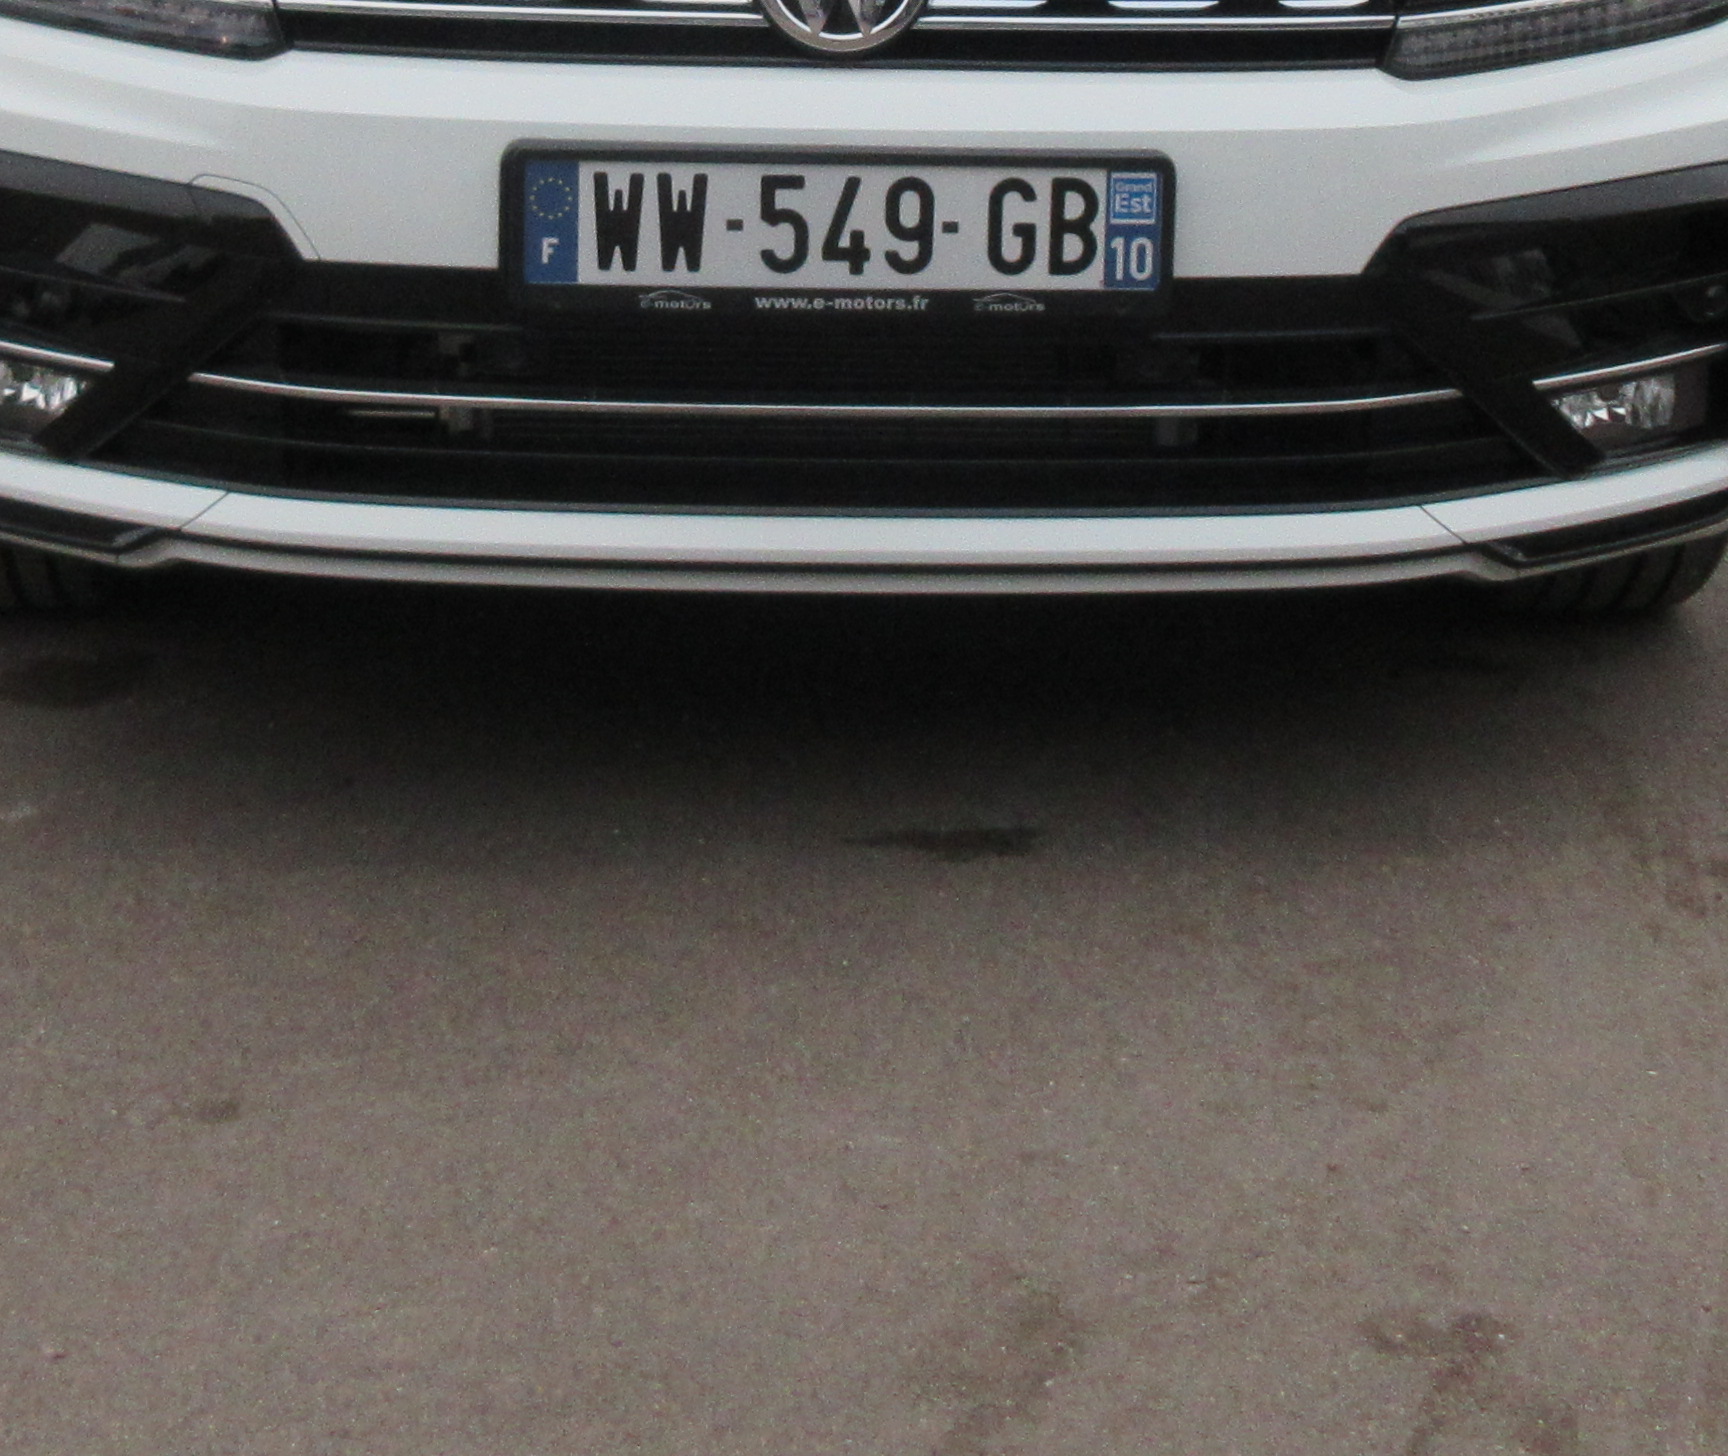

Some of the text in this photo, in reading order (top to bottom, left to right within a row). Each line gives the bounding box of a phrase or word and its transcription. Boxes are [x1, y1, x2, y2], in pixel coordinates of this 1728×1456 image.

[1114, 181, 1153, 193] Grand
[1114, 195, 1153, 213] Est
[593, 171, 1100, 276] WW-549-GB
[541, 236, 560, 265] F
[1110, 235, 1155, 282] 10
[754, 295, 929, 311] www.e-motors.fr
